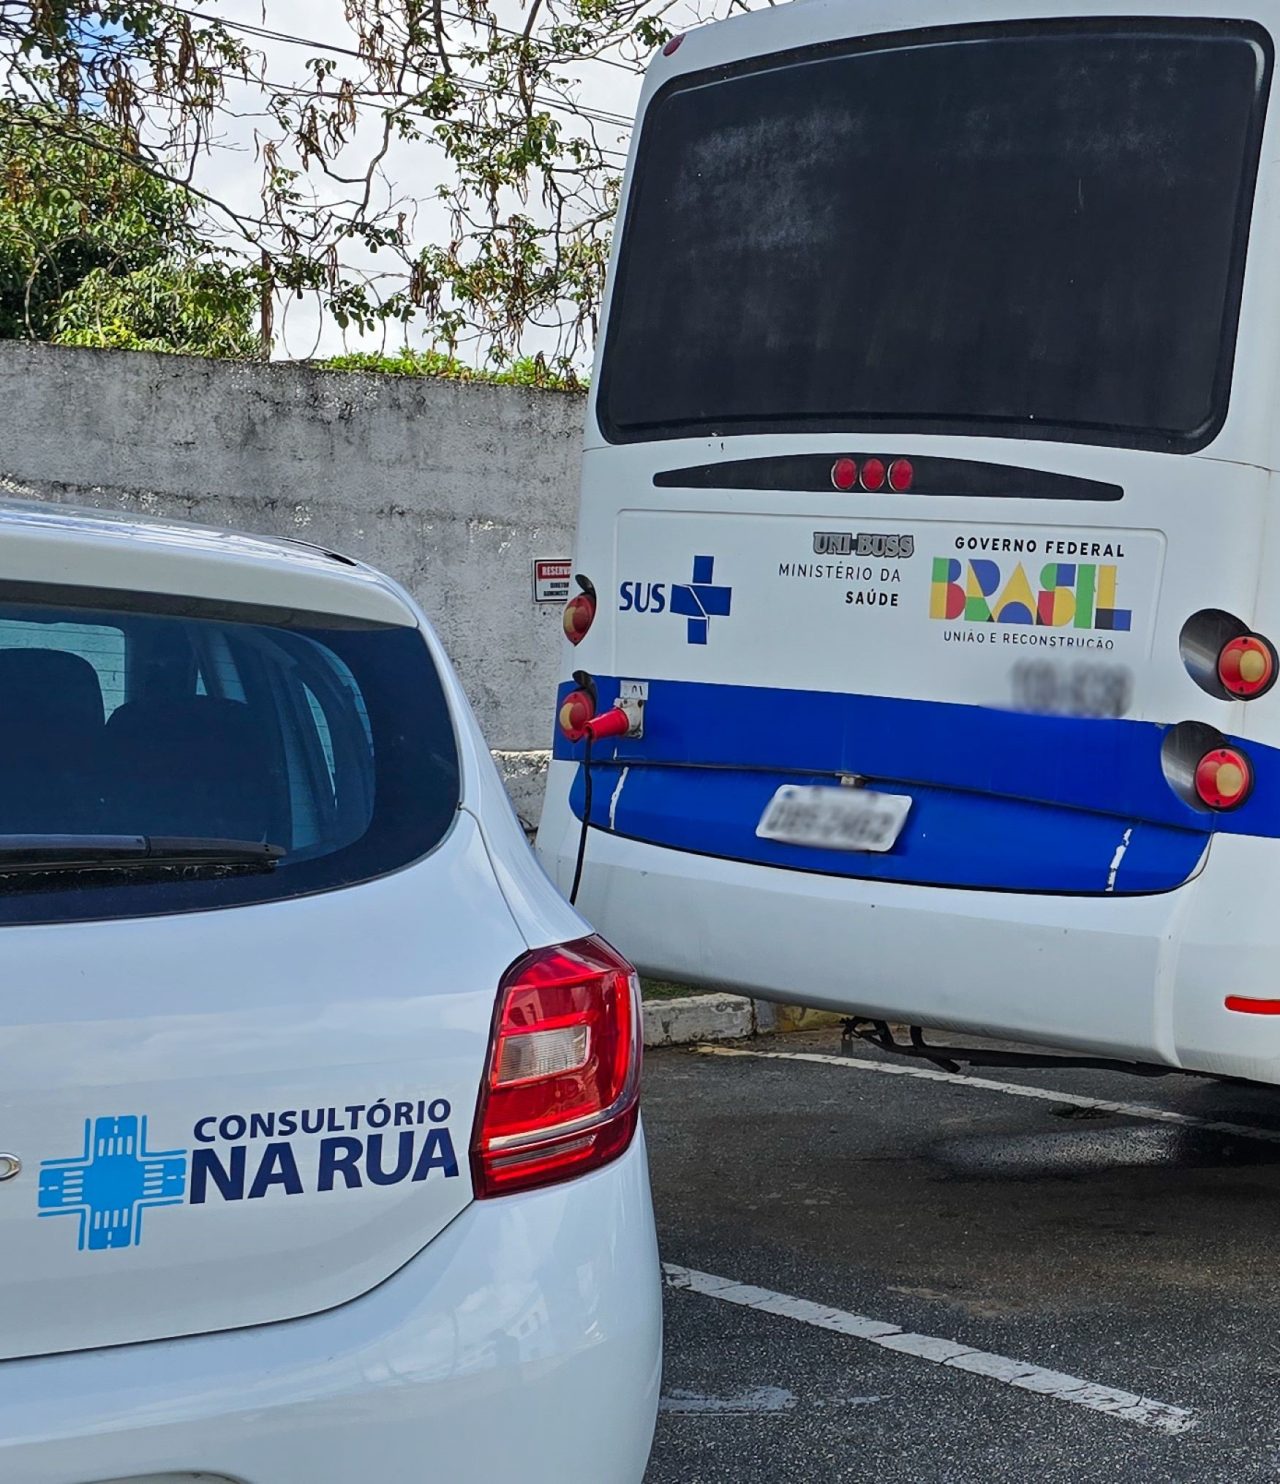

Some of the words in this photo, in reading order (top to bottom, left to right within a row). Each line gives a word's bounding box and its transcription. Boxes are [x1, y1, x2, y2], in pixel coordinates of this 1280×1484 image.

[955, 536, 1037, 553] GOVERNO
[1045, 541, 1125, 557] FEDERAL
[778, 561, 873, 581] MINISTÉRIO
[880, 568, 901, 582] DA
[619, 581, 666, 614] SUS
[845, 588, 899, 607] SAÚDE
[929, 557, 1132, 632] BRASIL
[943, 629, 985, 644] UNIÃO
[990, 632, 997, 644] E
[194, 1098, 451, 1143] CONSULTÓRIO
[190, 1142, 304, 1204] NA
[317, 1127, 459, 1192] RUA
